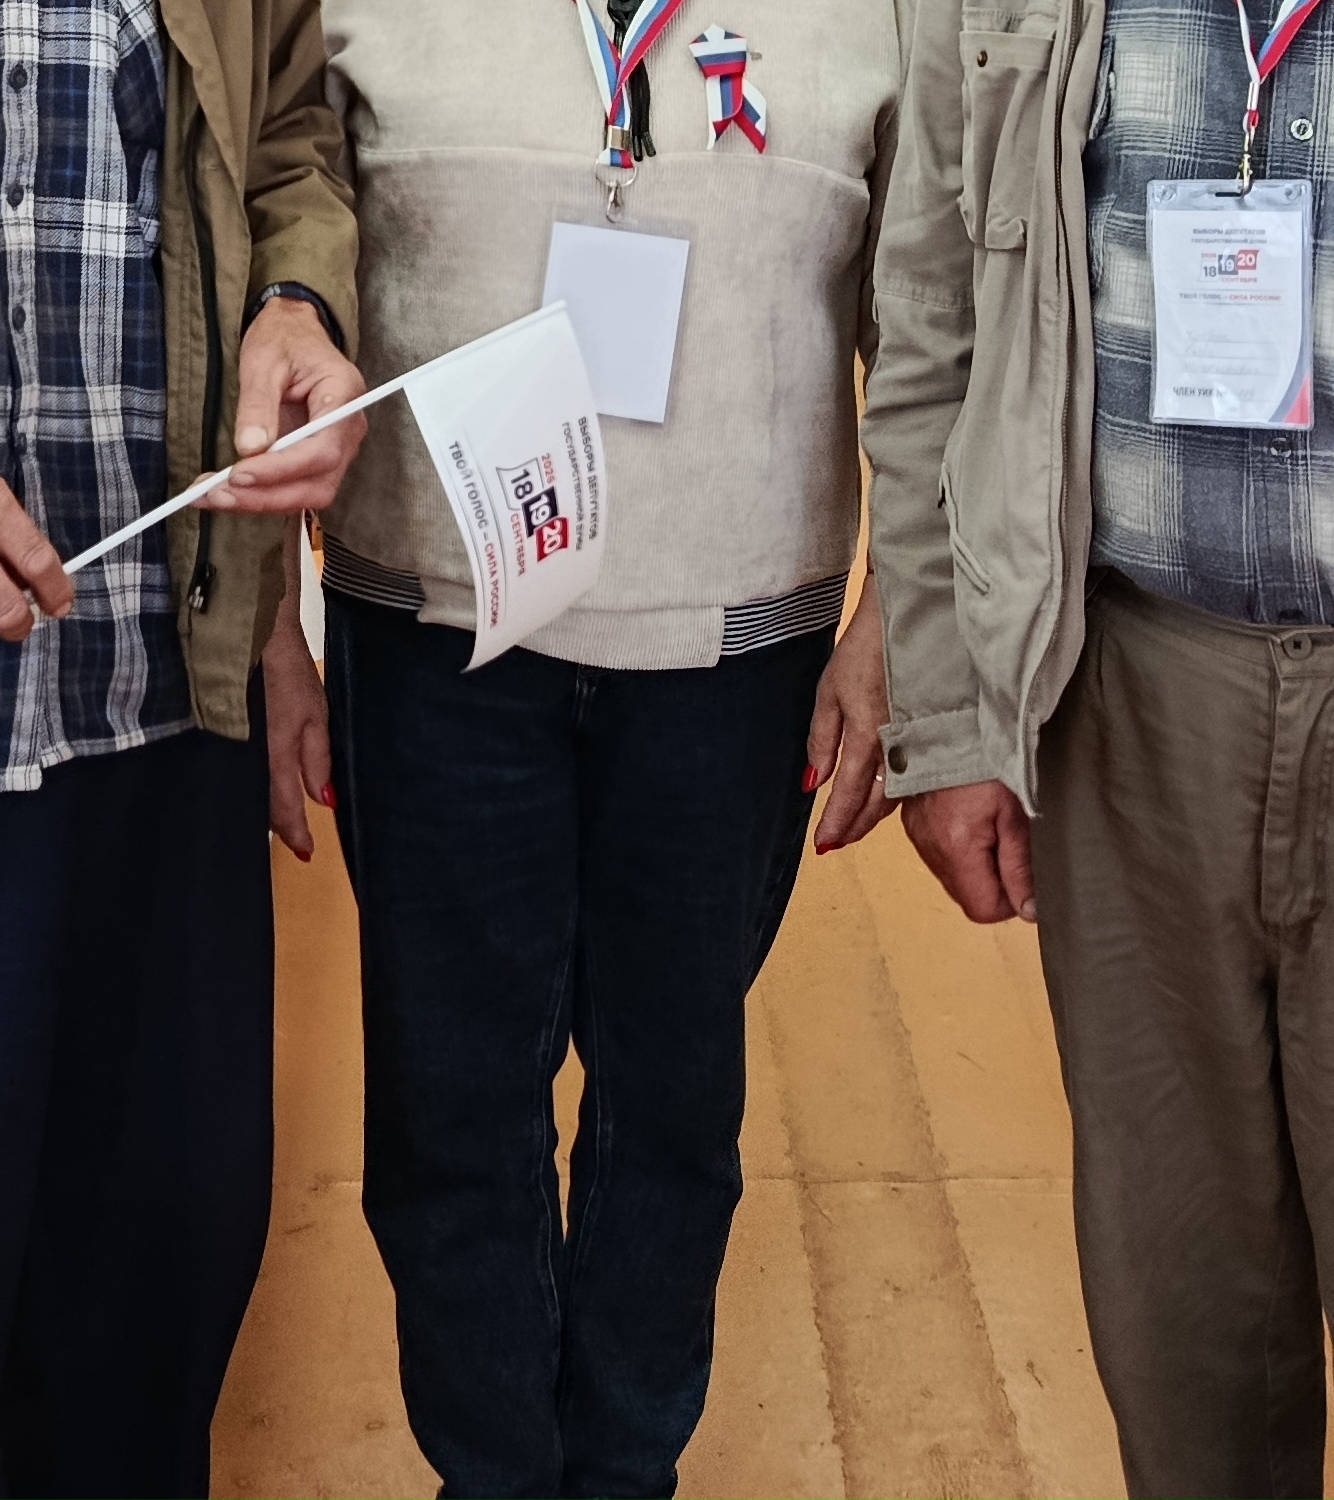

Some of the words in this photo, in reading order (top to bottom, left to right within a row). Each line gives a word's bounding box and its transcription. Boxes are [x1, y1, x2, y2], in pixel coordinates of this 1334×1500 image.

[1192, 228, 1224, 236] ВЫБОРЫ
[1224, 228, 1266, 236] ДЕПУТАТОВ
[1202, 265, 1217, 278] 18
[1219, 257, 1235, 273] 19
[1237, 253, 1256, 267] 20
[1221, 276, 1258, 284] СЕНТЯБРЯ
[1179, 292, 1198, 301] ТВОЙ
[1173, 386, 1196, 397] ЧЛЕН
[1196, 387, 1214, 397] УИК
[562, 421, 583, 523] ГОСУДАРСТВЕННОЙ
[578, 416, 598, 472] ВЫБОРЫ
[448, 440, 472, 481] ТВОЙ
[464, 482, 488, 530] ГОЛОС
[484, 542, 498, 578] СИЛА
[510, 468, 533, 500] 18
[529, 493, 551, 526] 19
[542, 519, 562, 553] 20
[586, 475, 599, 541] ДЕПУТАТОВ
[510, 512, 526, 577] СЕНТЯБРЯ
